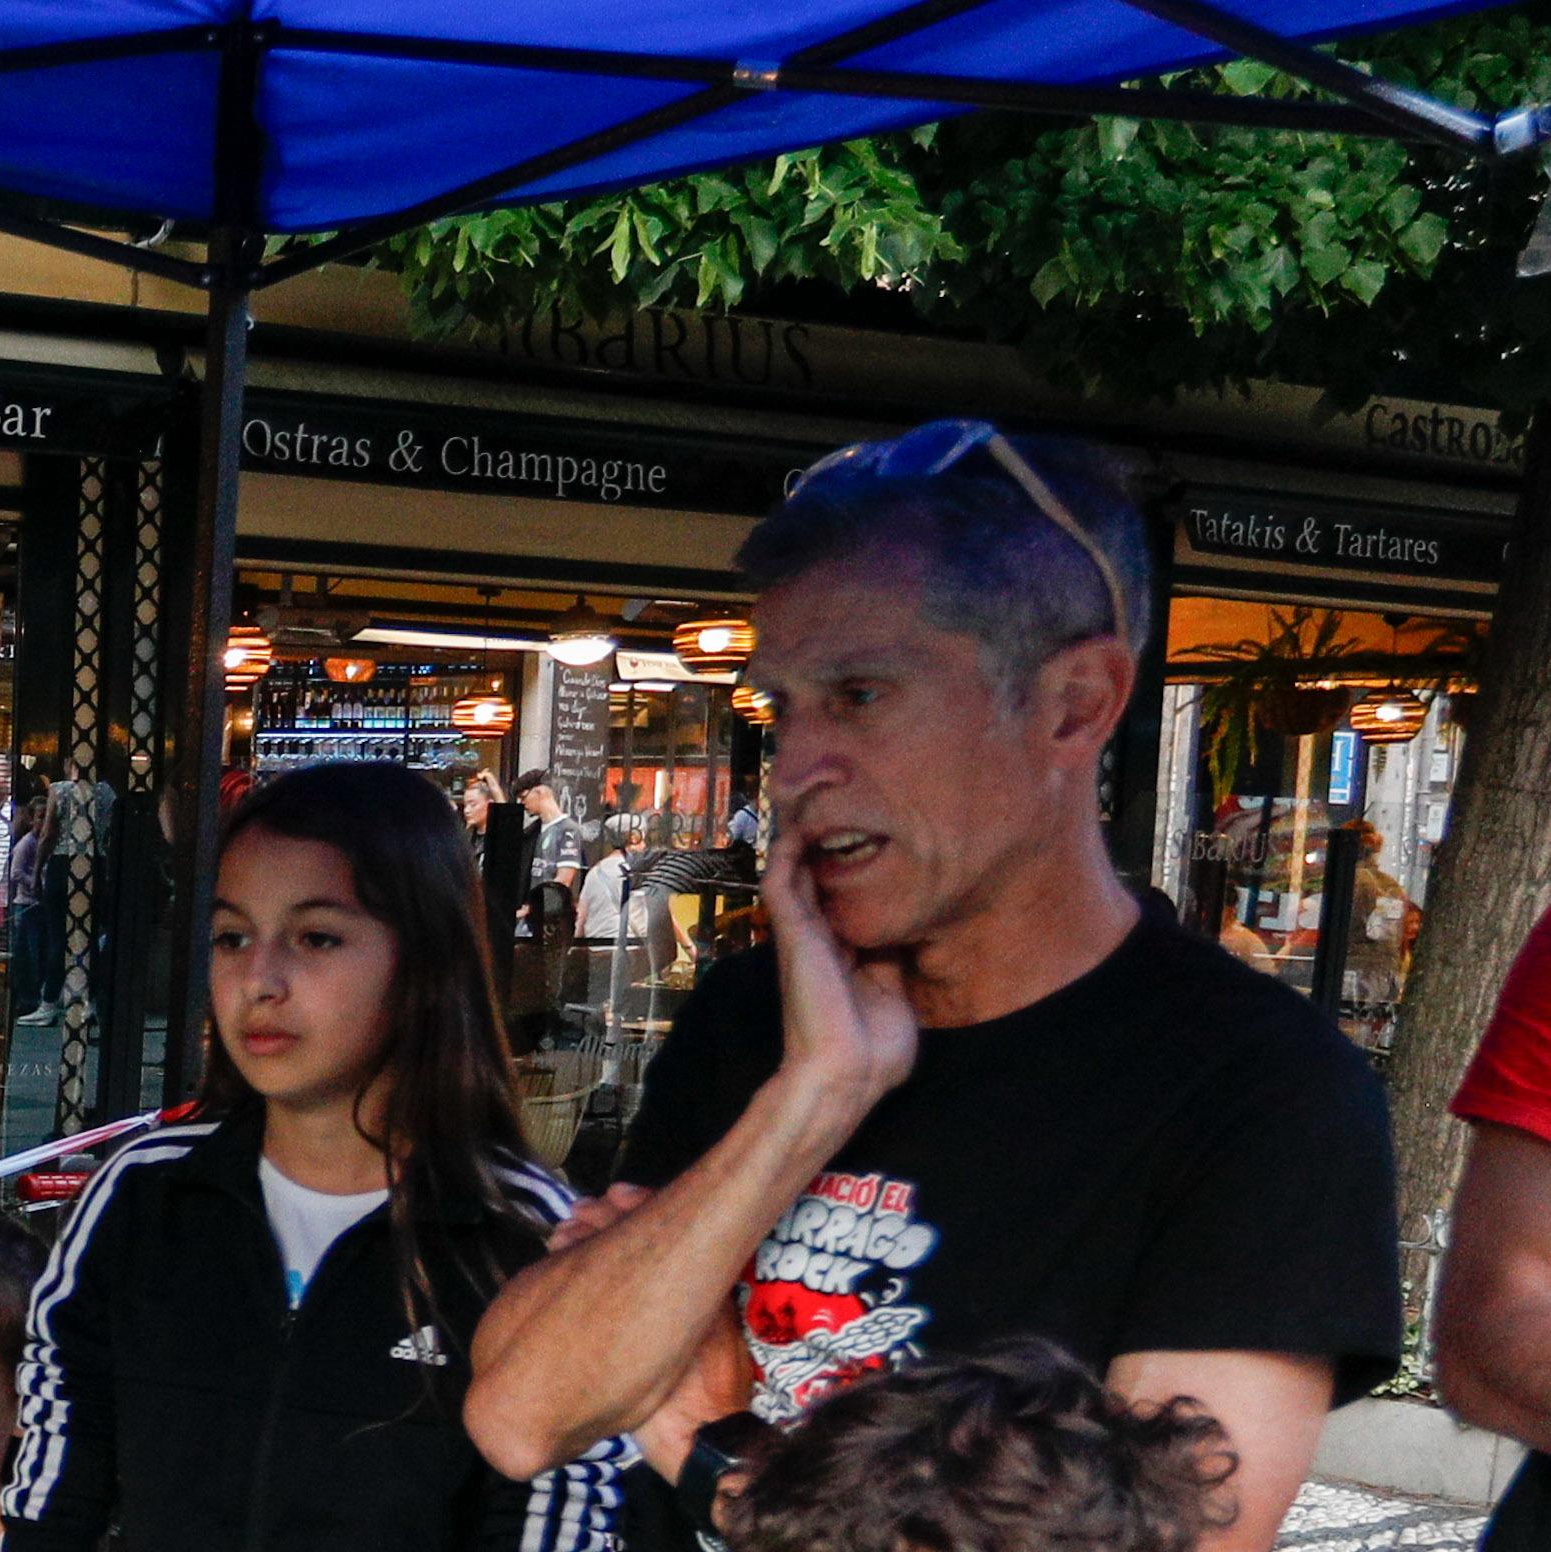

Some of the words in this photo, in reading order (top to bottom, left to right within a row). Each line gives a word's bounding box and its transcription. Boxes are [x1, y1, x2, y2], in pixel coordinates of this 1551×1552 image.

[242, 417, 371, 469] Ostras
[388, 430, 424, 473] &
[440, 435, 667, 502] Champagne
[1190, 509, 1286, 551] Tatakis
[1295, 516, 1322, 555] &
[1333, 523, 1440, 565] Tartares
[880, 1182, 910, 1213] EL
[755, 1239, 873, 1295] ROCK
